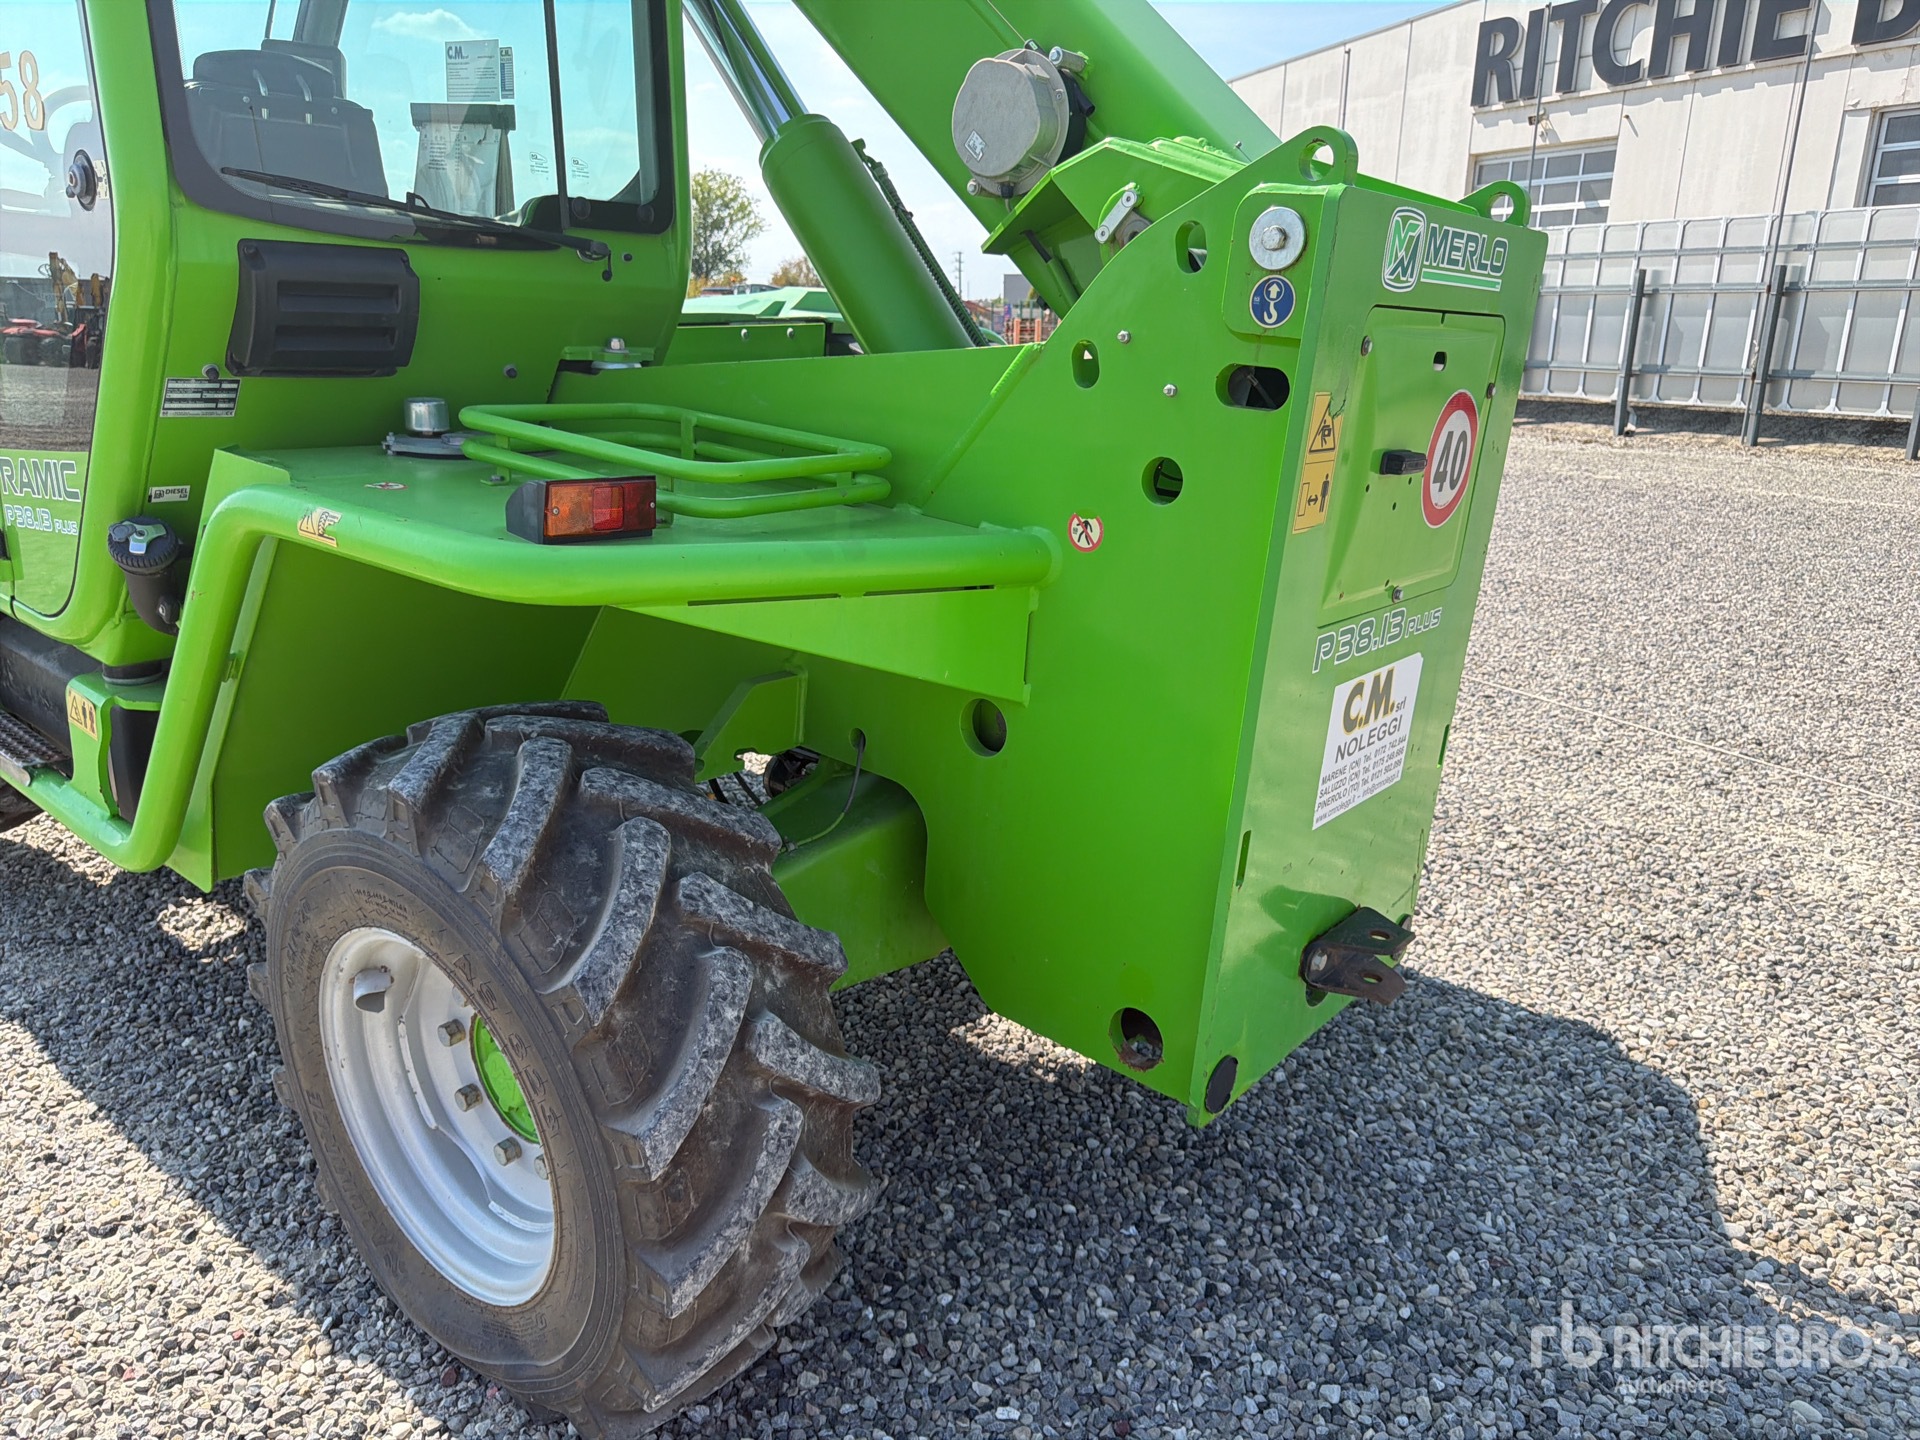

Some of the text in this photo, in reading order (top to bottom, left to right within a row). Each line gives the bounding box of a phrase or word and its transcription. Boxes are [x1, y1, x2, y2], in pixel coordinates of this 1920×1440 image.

[1470, 0, 1814, 107] RITCHIE
[1423, 223, 1509, 277] MERLO
[1432, 429, 1468, 492] 40
[165, 487, 189, 495] DIESEL
[3, 503, 79, 536] P38.13 PLUS
[1312, 607, 1442, 674] P38.13 PLUS
[1342, 666, 1407, 735] C.M. srl
[1335, 715, 1403, 763] NOLEGGI
[1319, 777, 1347, 798] SALUZZO
[1348, 770, 1360, 785] (CN)
[1321, 765, 1347, 785] MARENE
[1348, 758, 1361, 773] (CN)
[1316, 788, 1348, 812] PINEROLO
